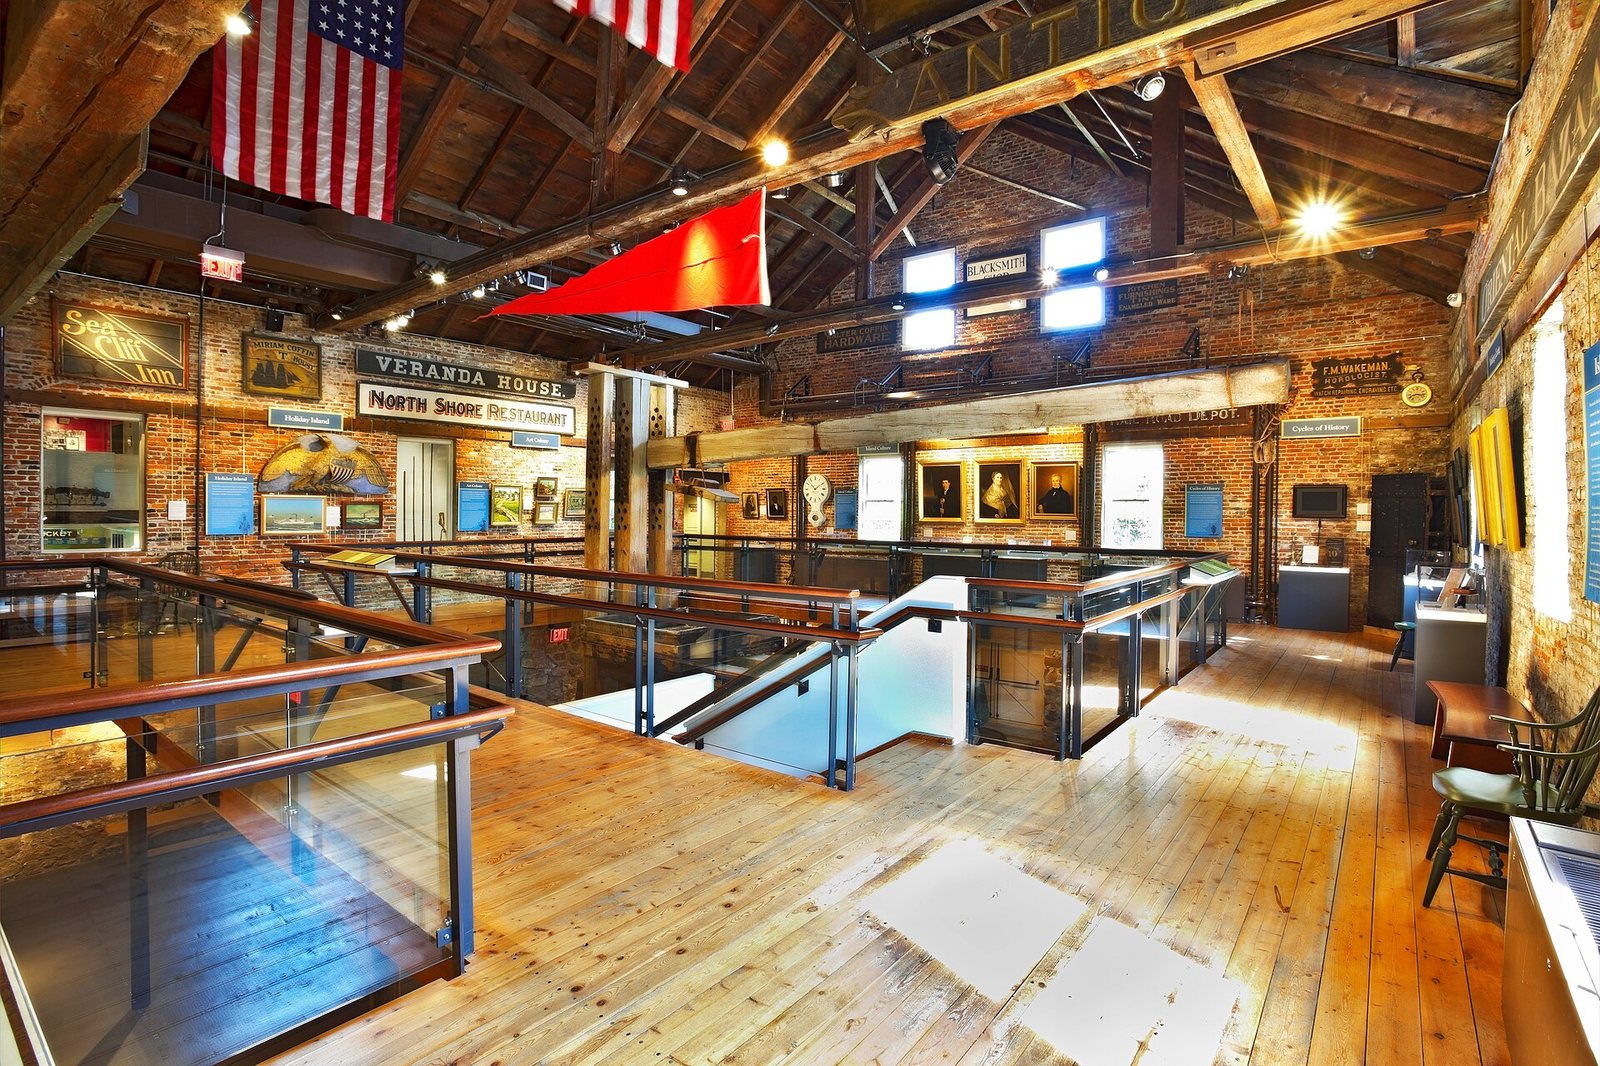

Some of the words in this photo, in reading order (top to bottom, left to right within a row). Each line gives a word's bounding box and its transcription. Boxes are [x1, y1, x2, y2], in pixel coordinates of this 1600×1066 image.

[208, 258, 237, 279] EXIT
[967, 257, 1025, 276] BLACKSMITH
[1118, 286, 1176, 300] FURNISHINGS
[63, 310, 118, 336] Sea
[860, 324, 888, 334] COFFIN
[95, 335, 149, 362] Cliff
[253, 341, 285, 350] MIRIAM
[287, 344, 315, 357] COFFIN
[824, 332, 890, 349] HARDWARE
[136, 364, 182, 386] Inn.
[376, 355, 485, 386] VERANDA
[497, 375, 566, 397] HOUSE.
[368, 390, 427, 413] NORTH
[433, 397, 483, 419] SHORE
[487, 403, 567, 427] RESTAURANT
[284, 414, 310, 424] Holiday
[311, 416, 330, 425] Island
[1292, 425, 1314, 433] Cycles
[1324, 424, 1350, 433] History
[553, 628, 569, 640] EXIT
